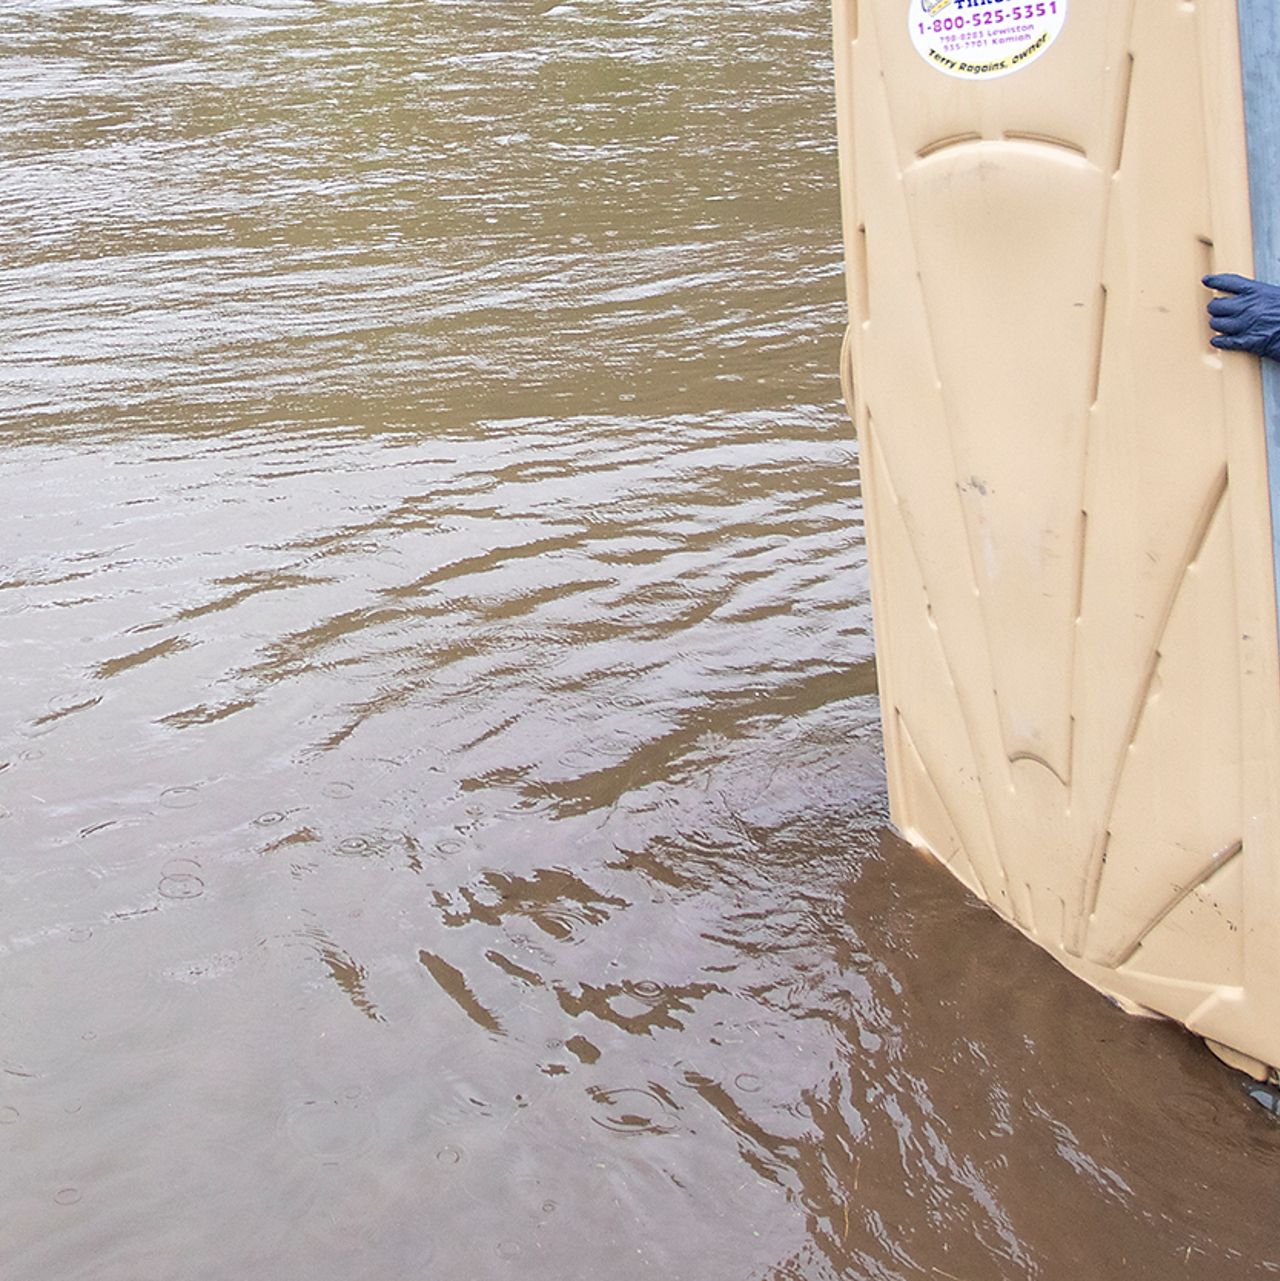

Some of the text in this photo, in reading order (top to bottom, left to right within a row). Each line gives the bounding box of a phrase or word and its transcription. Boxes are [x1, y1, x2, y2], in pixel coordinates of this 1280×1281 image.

[918, 1, 1057, 34] 1-800-525-5351
[987, 24, 1035, 37] Lewiston
[992, 33, 1032, 45] Kamiah
[928, 48, 957, 69] Terry
[1011, 33, 1048, 64] owner
